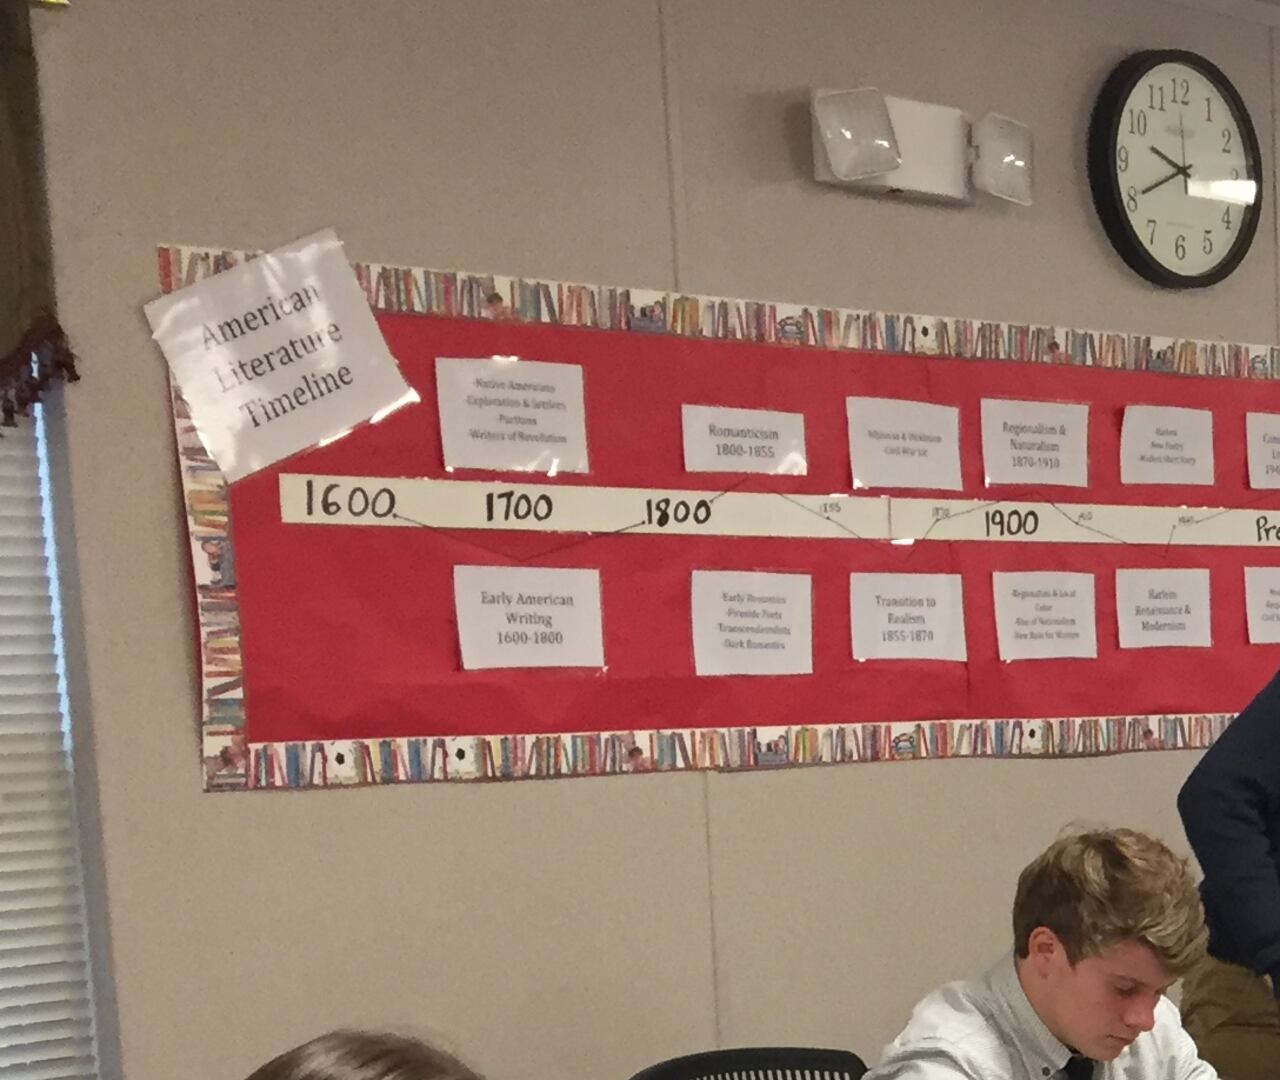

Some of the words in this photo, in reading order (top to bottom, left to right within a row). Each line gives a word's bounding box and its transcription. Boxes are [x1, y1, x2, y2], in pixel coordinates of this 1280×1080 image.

[1148, 84, 1166, 112] 11
[1170, 78, 1190, 105] 12
[1128, 108, 1147, 136] 10
[1205, 97, 1213, 122] 1
[1221, 128, 1231, 153] 2
[1118, 145, 1129, 172] 9
[1126, 186, 1138, 213] 8
[1221, 205, 1232, 230] 4
[1146, 219, 1157, 245] 7
[1202, 230, 1213, 255] 5
[1174, 234, 1186, 260] 6
[201, 284, 321, 350] American
[214, 322, 344, 392] Literature
[239, 364, 354, 428] Timeline
[708, 423, 779, 441] Romanticism
[1002, 421, 1057, 436] Regionalism
[715, 444, 776, 459] 1800-1855
[1010, 438, 1060, 452] Naturalism
[1012, 456, 1061, 469] 1870-1910
[306, 480, 396, 518] 1600
[486, 491, 553, 521] 1700
[646, 498, 712, 527] 1800
[985, 509, 1039, 536] 1900
[480, 591, 513, 607] Early
[515, 592, 574, 607] American
[875, 594, 924, 608] Transition
[925, 597, 936, 608] to
[505, 612, 553, 629] Writing
[887, 612, 926, 625] Realism
[497, 631, 564, 645] 1600-1800
[882, 629, 934, 642] 1855-1870
